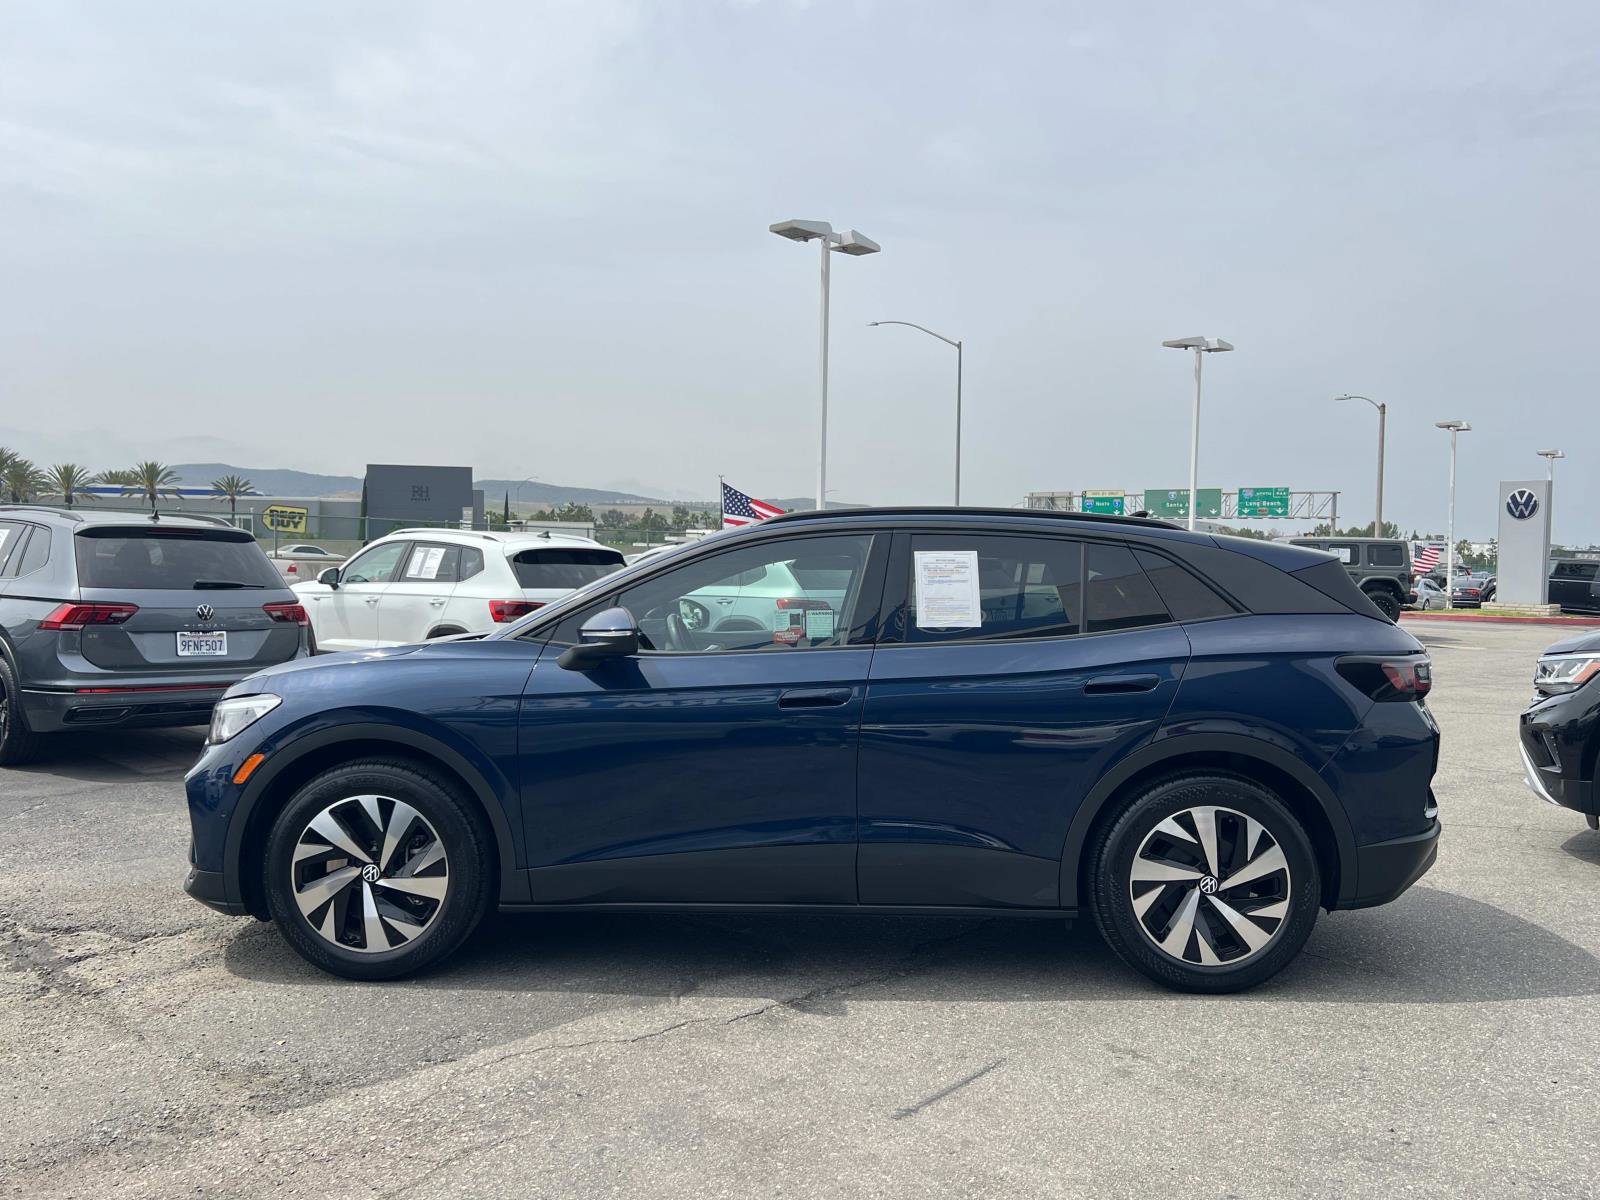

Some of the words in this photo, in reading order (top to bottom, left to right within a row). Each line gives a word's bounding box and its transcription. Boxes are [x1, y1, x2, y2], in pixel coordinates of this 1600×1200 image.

[269, 510, 305, 520] BEST
[271, 519, 302, 529] BUY
[181, 640, 223, 652] 9FNF507
